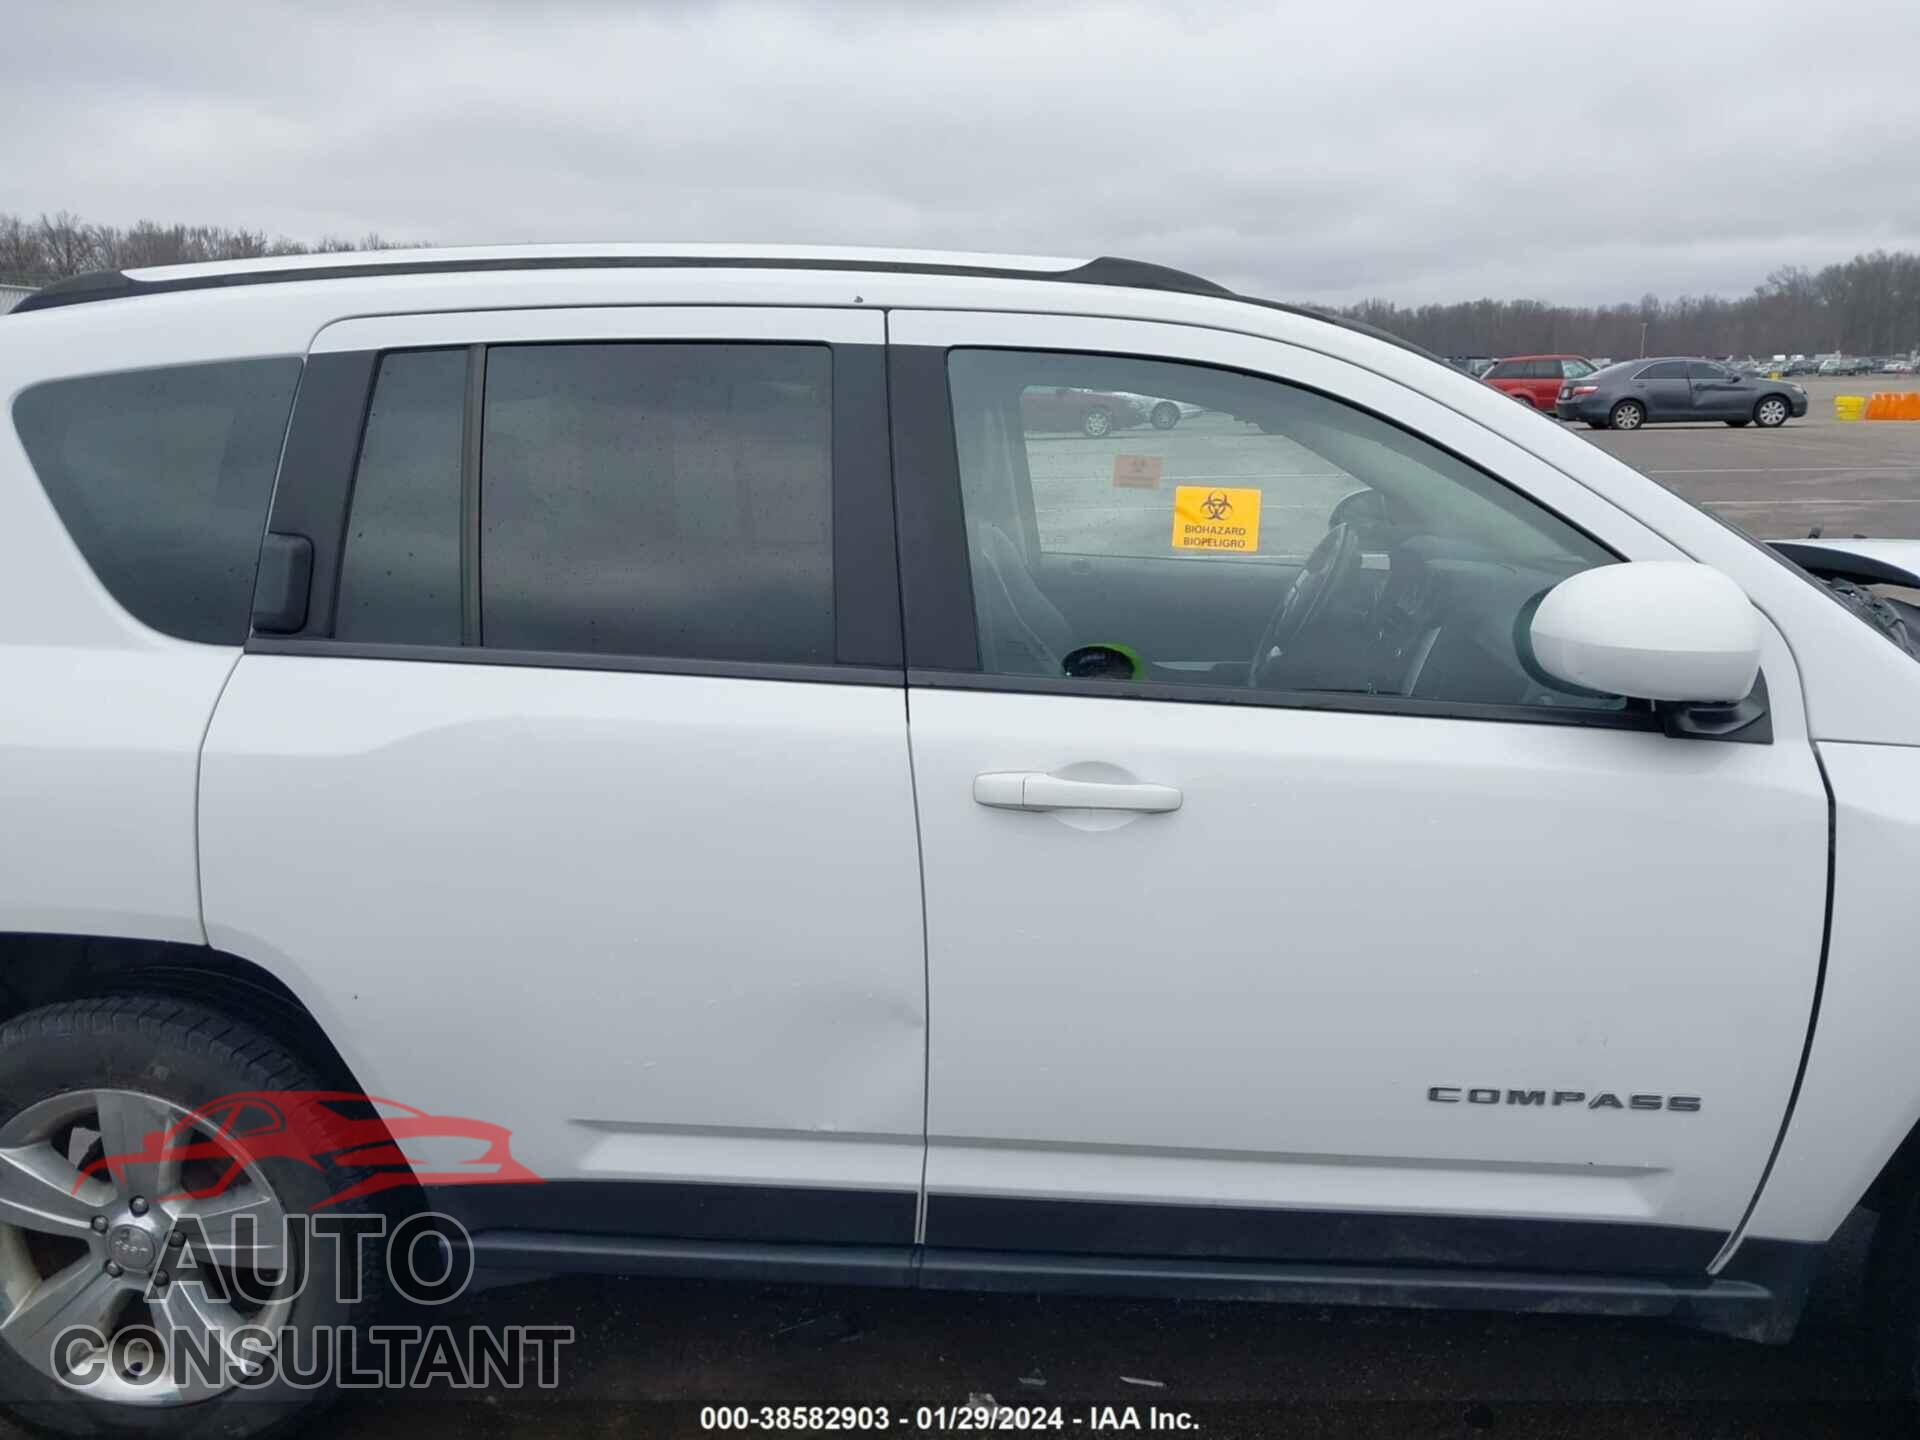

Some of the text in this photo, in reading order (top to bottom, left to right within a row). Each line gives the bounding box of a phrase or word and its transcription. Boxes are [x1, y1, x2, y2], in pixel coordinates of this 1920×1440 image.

[1184, 524, 1247, 537] BIOHAZARD
[1183, 536, 1247, 550] BIOPELIGRO
[1428, 1086, 1702, 1112] COMPASS
